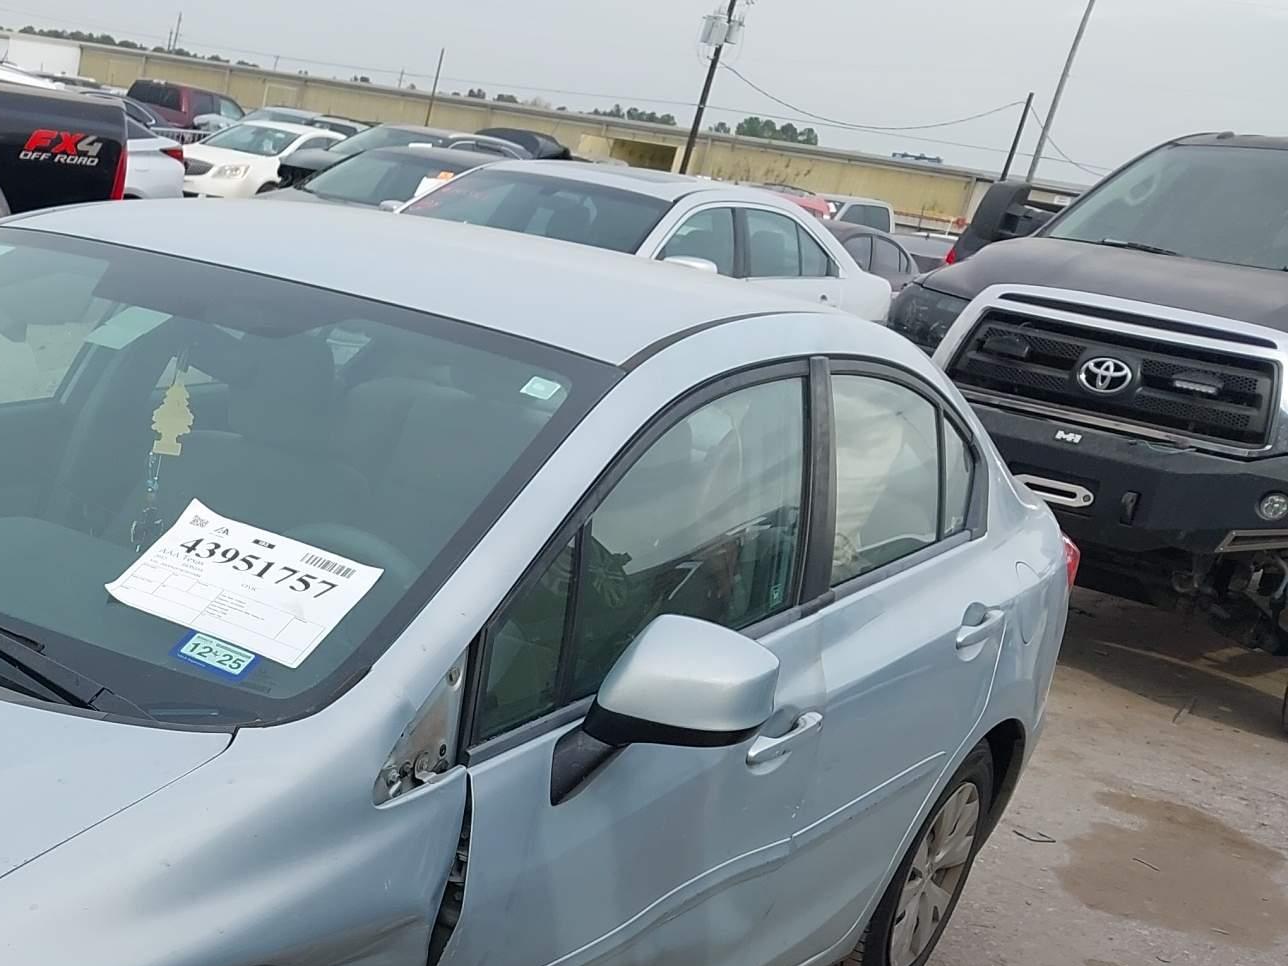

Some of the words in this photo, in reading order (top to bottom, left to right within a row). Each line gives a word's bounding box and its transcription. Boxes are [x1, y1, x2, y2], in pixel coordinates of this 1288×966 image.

[24, 129, 103, 156] FX4
[19, 151, 51, 160] OFF
[54, 154, 99, 166] ROAD
[180, 538, 339, 598] 43951757
[189, 642, 212, 658] 12
[216, 654, 245, 670] 25
